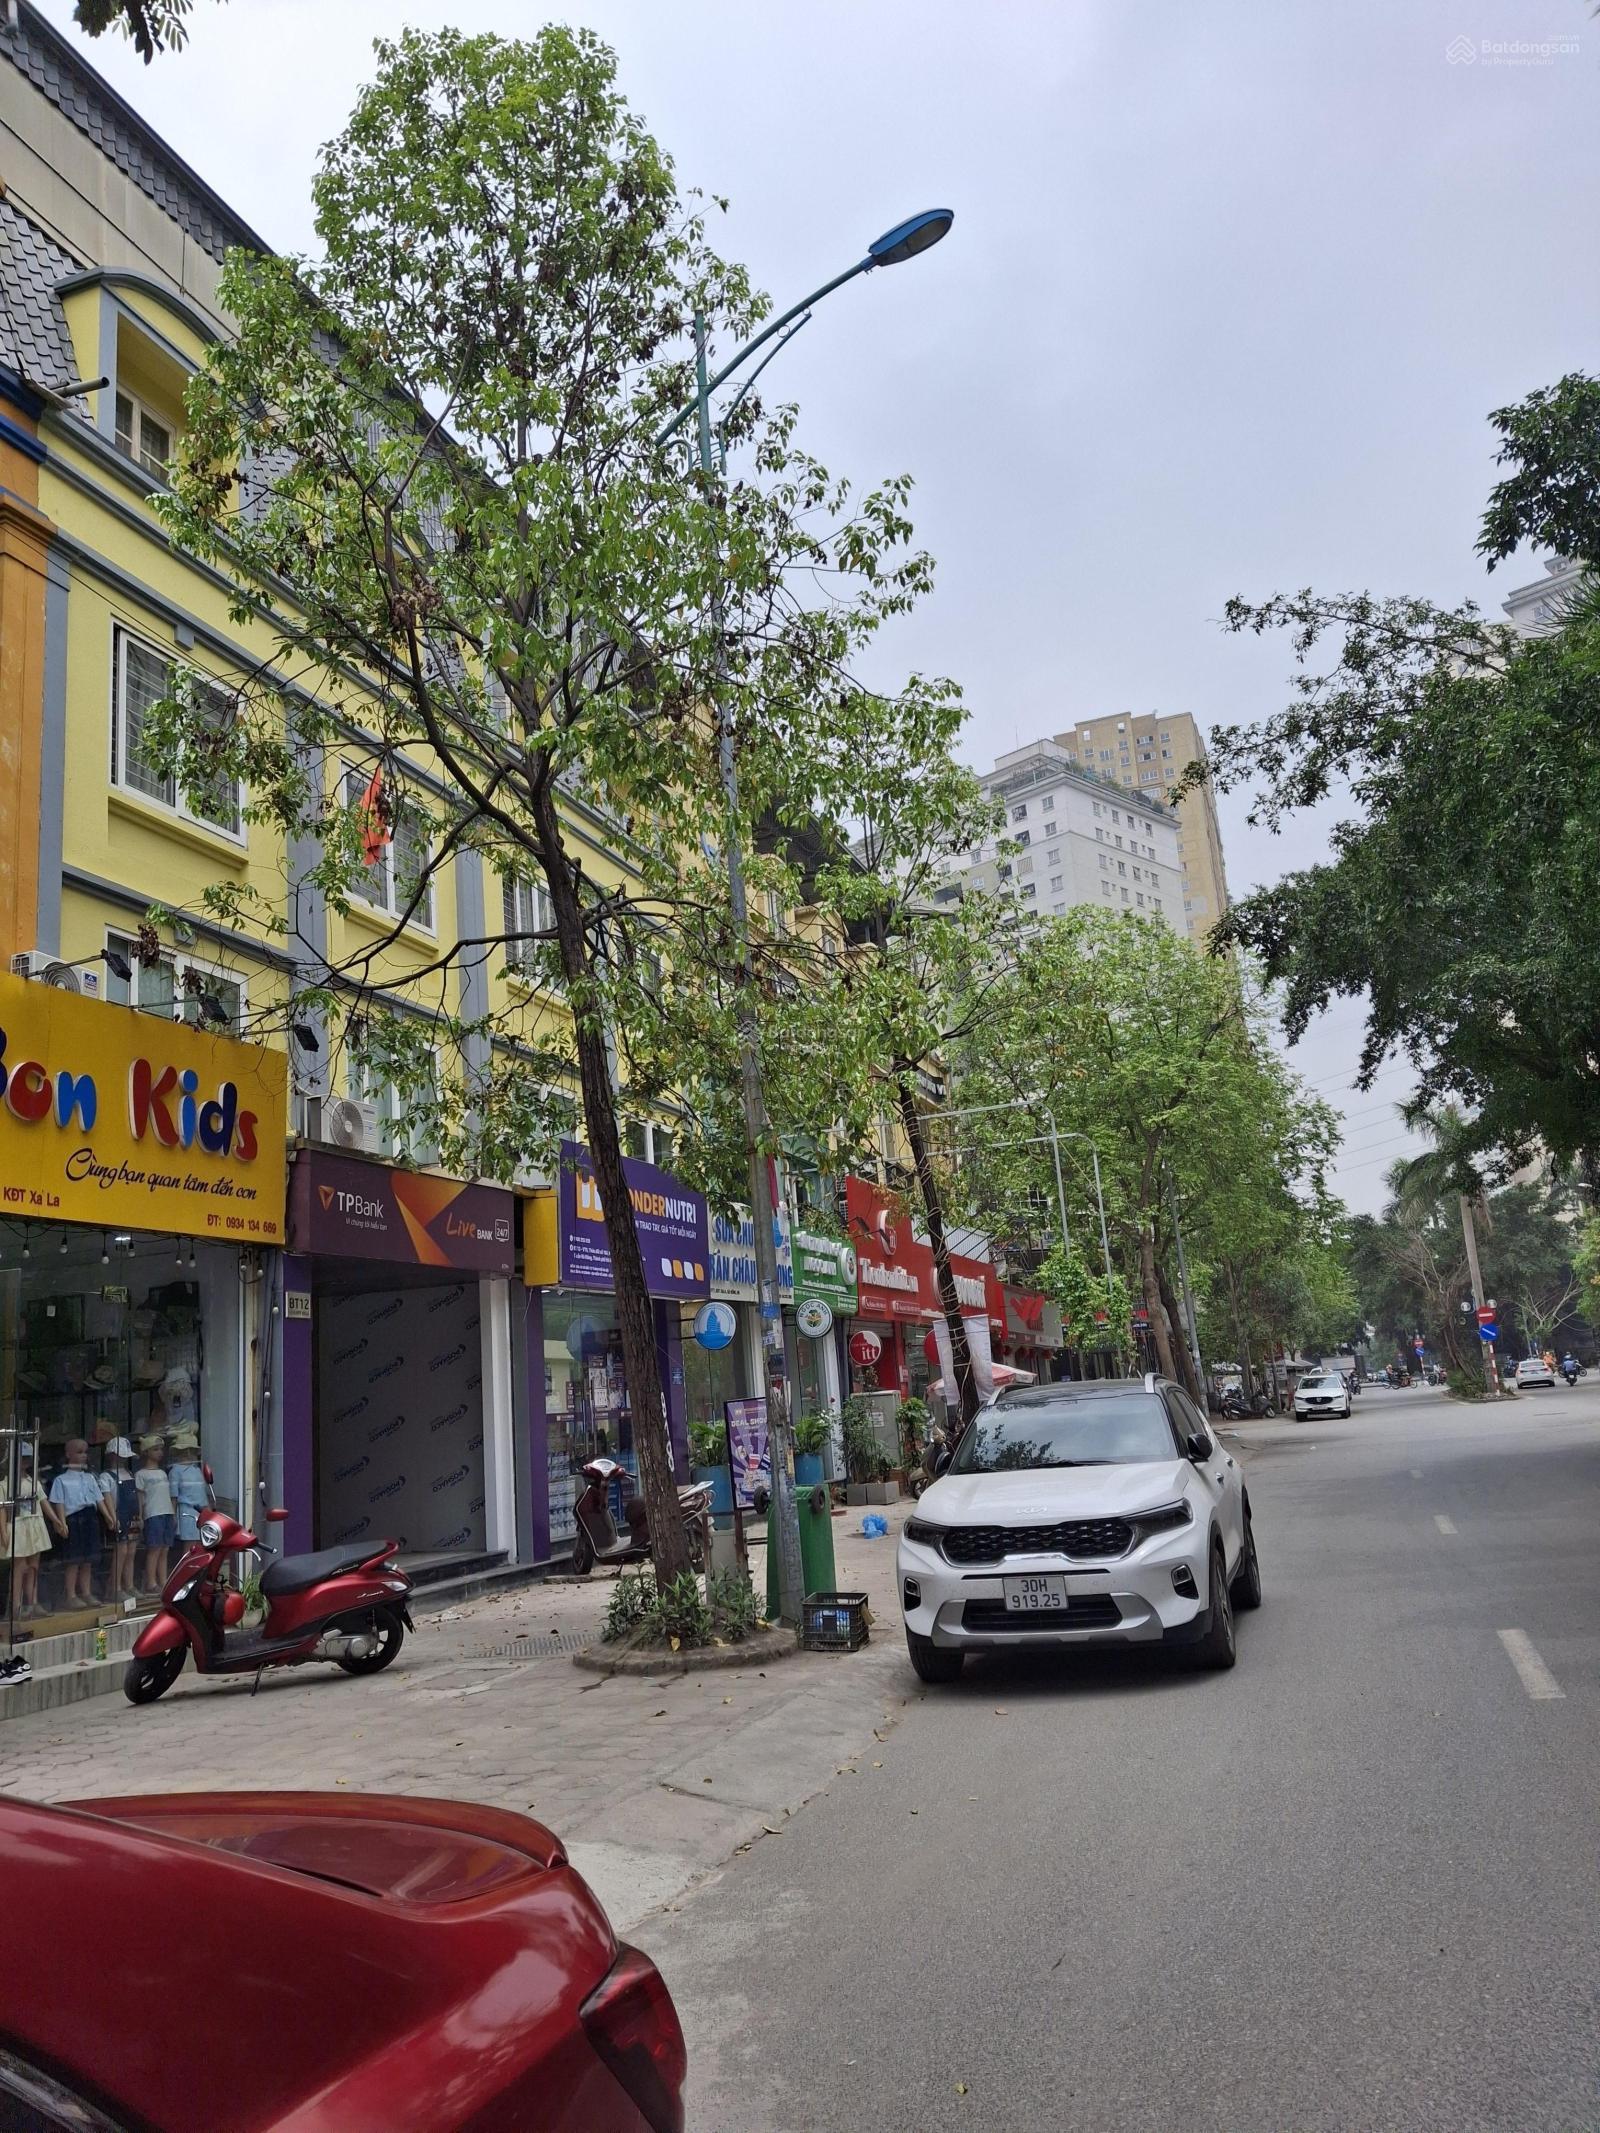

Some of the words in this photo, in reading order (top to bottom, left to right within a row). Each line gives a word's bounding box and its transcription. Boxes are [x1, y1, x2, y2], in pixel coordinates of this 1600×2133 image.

[128, 1057, 259, 1162] Kids
[66, 1148, 118, 1189] Cùng
[147, 1173, 180, 1192] quan
[236, 1187, 257, 1200] con
[46, 1193, 60, 1207] La
[337, 1191, 384, 1219] TPBank
[446, 1212, 476, 1239] Live
[477, 1229, 493, 1241] BANK
[861, 1346, 877, 1361] itt
[1020, 1578, 1048, 1593] 30H
[1011, 1593, 1061, 1609] 919.25
